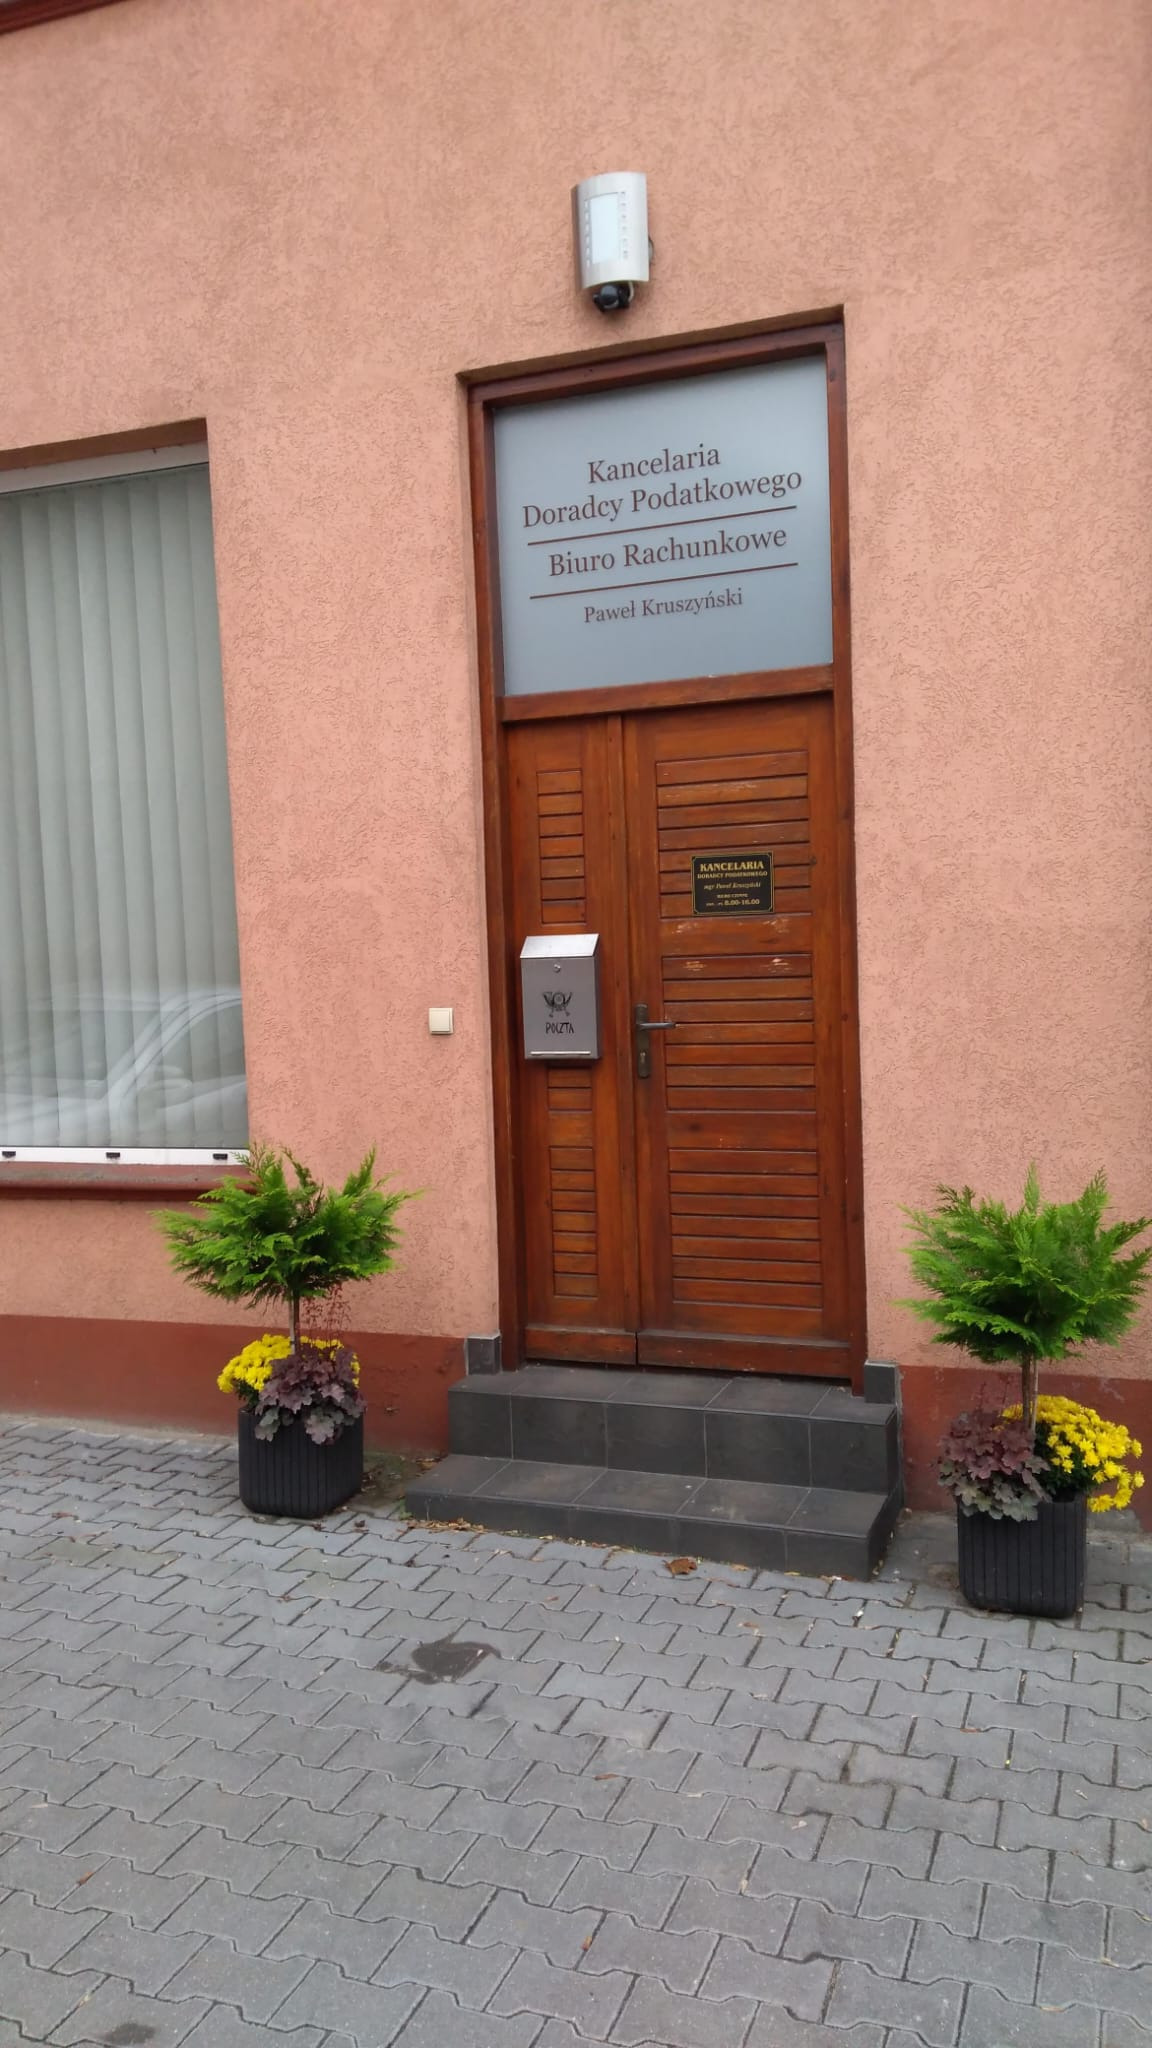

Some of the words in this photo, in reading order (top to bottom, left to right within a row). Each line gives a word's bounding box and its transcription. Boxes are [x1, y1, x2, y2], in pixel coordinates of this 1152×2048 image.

[588, 443, 721, 484] Kancelaria
[523, 495, 623, 528] Doradcy
[631, 471, 802, 512] Podatkowego
[549, 551, 615, 577] Biuro
[624, 529, 787, 567] Rachunkowe
[584, 601, 635, 623] Paweł
[642, 587, 743, 617] Kruszyński
[700, 861, 764, 872] KANCELARIA
[545, 1022, 574, 1034] POCZTA
